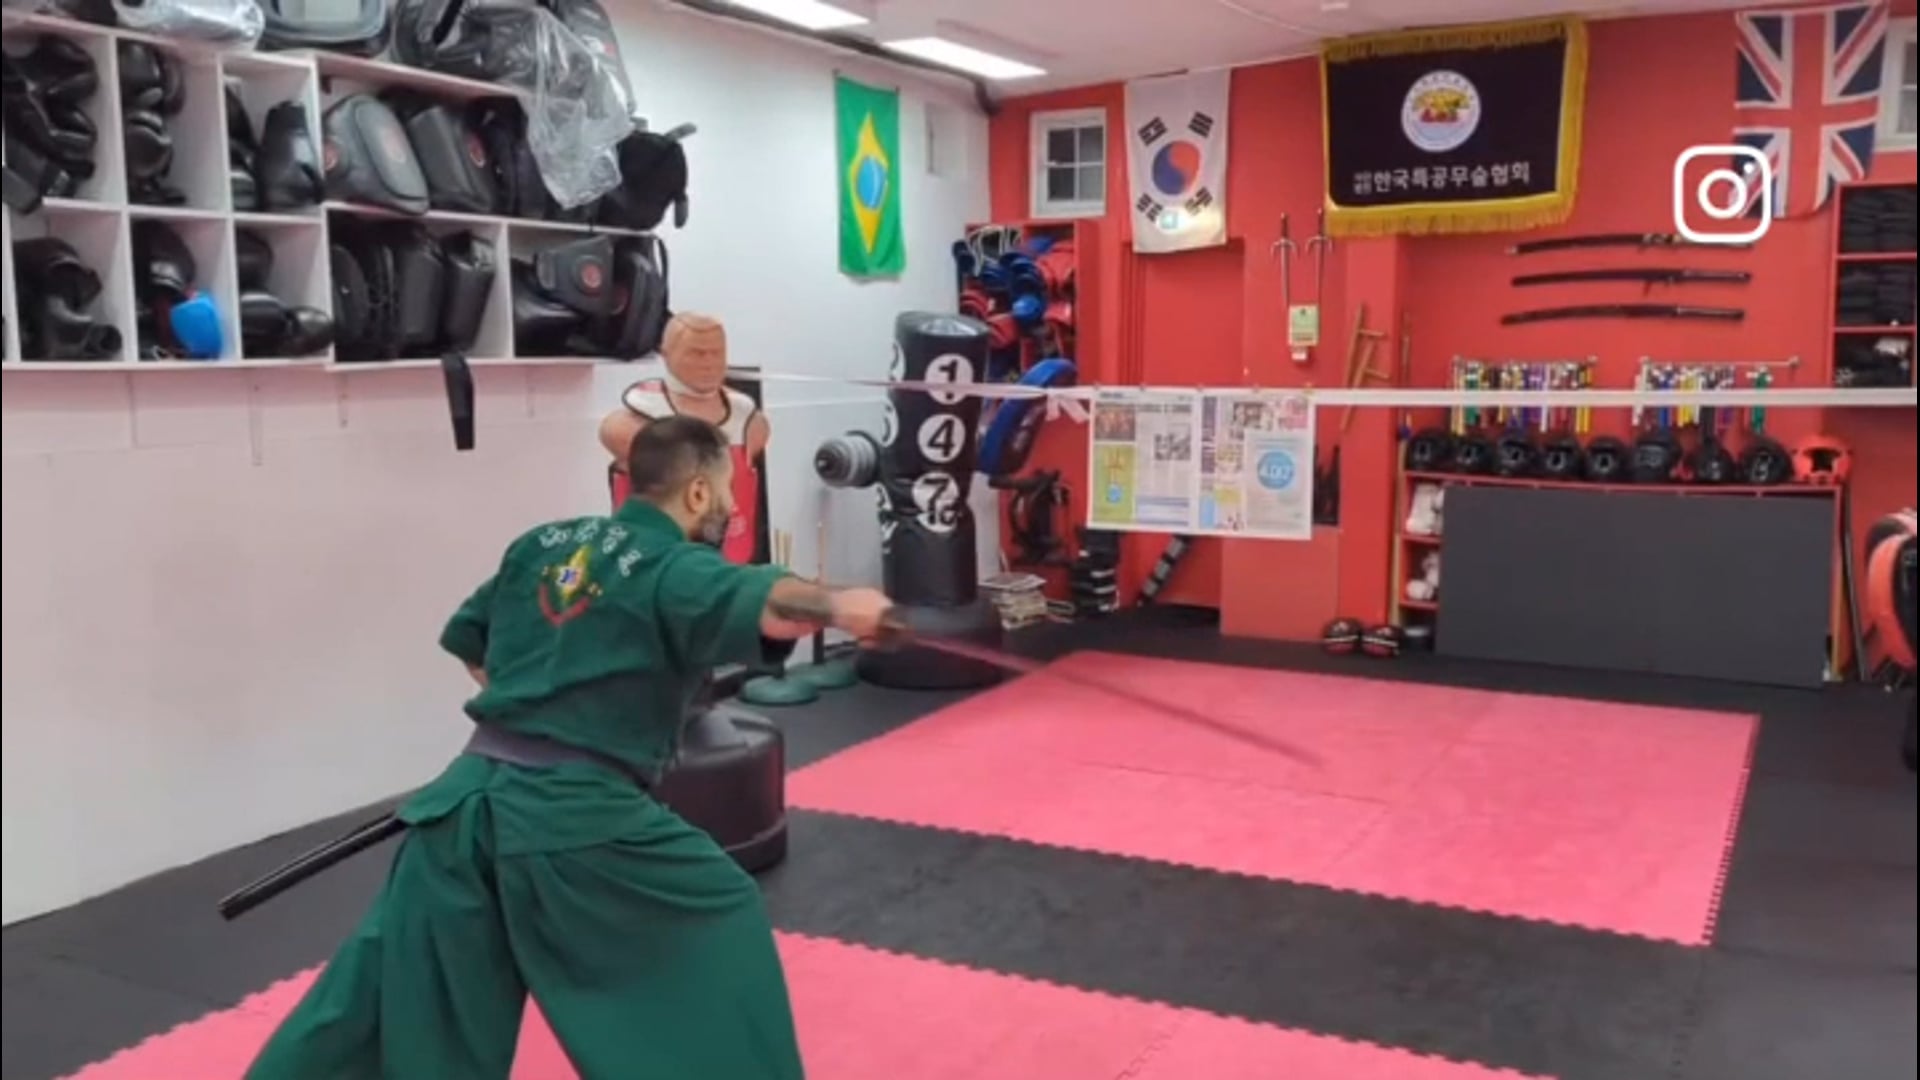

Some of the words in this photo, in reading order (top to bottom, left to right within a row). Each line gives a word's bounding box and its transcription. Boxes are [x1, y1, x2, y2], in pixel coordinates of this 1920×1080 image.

[1374, 161, 1530, 193] 한국특공무술협회
[937, 359, 958, 399] 1
[927, 418, 955, 458] 4
